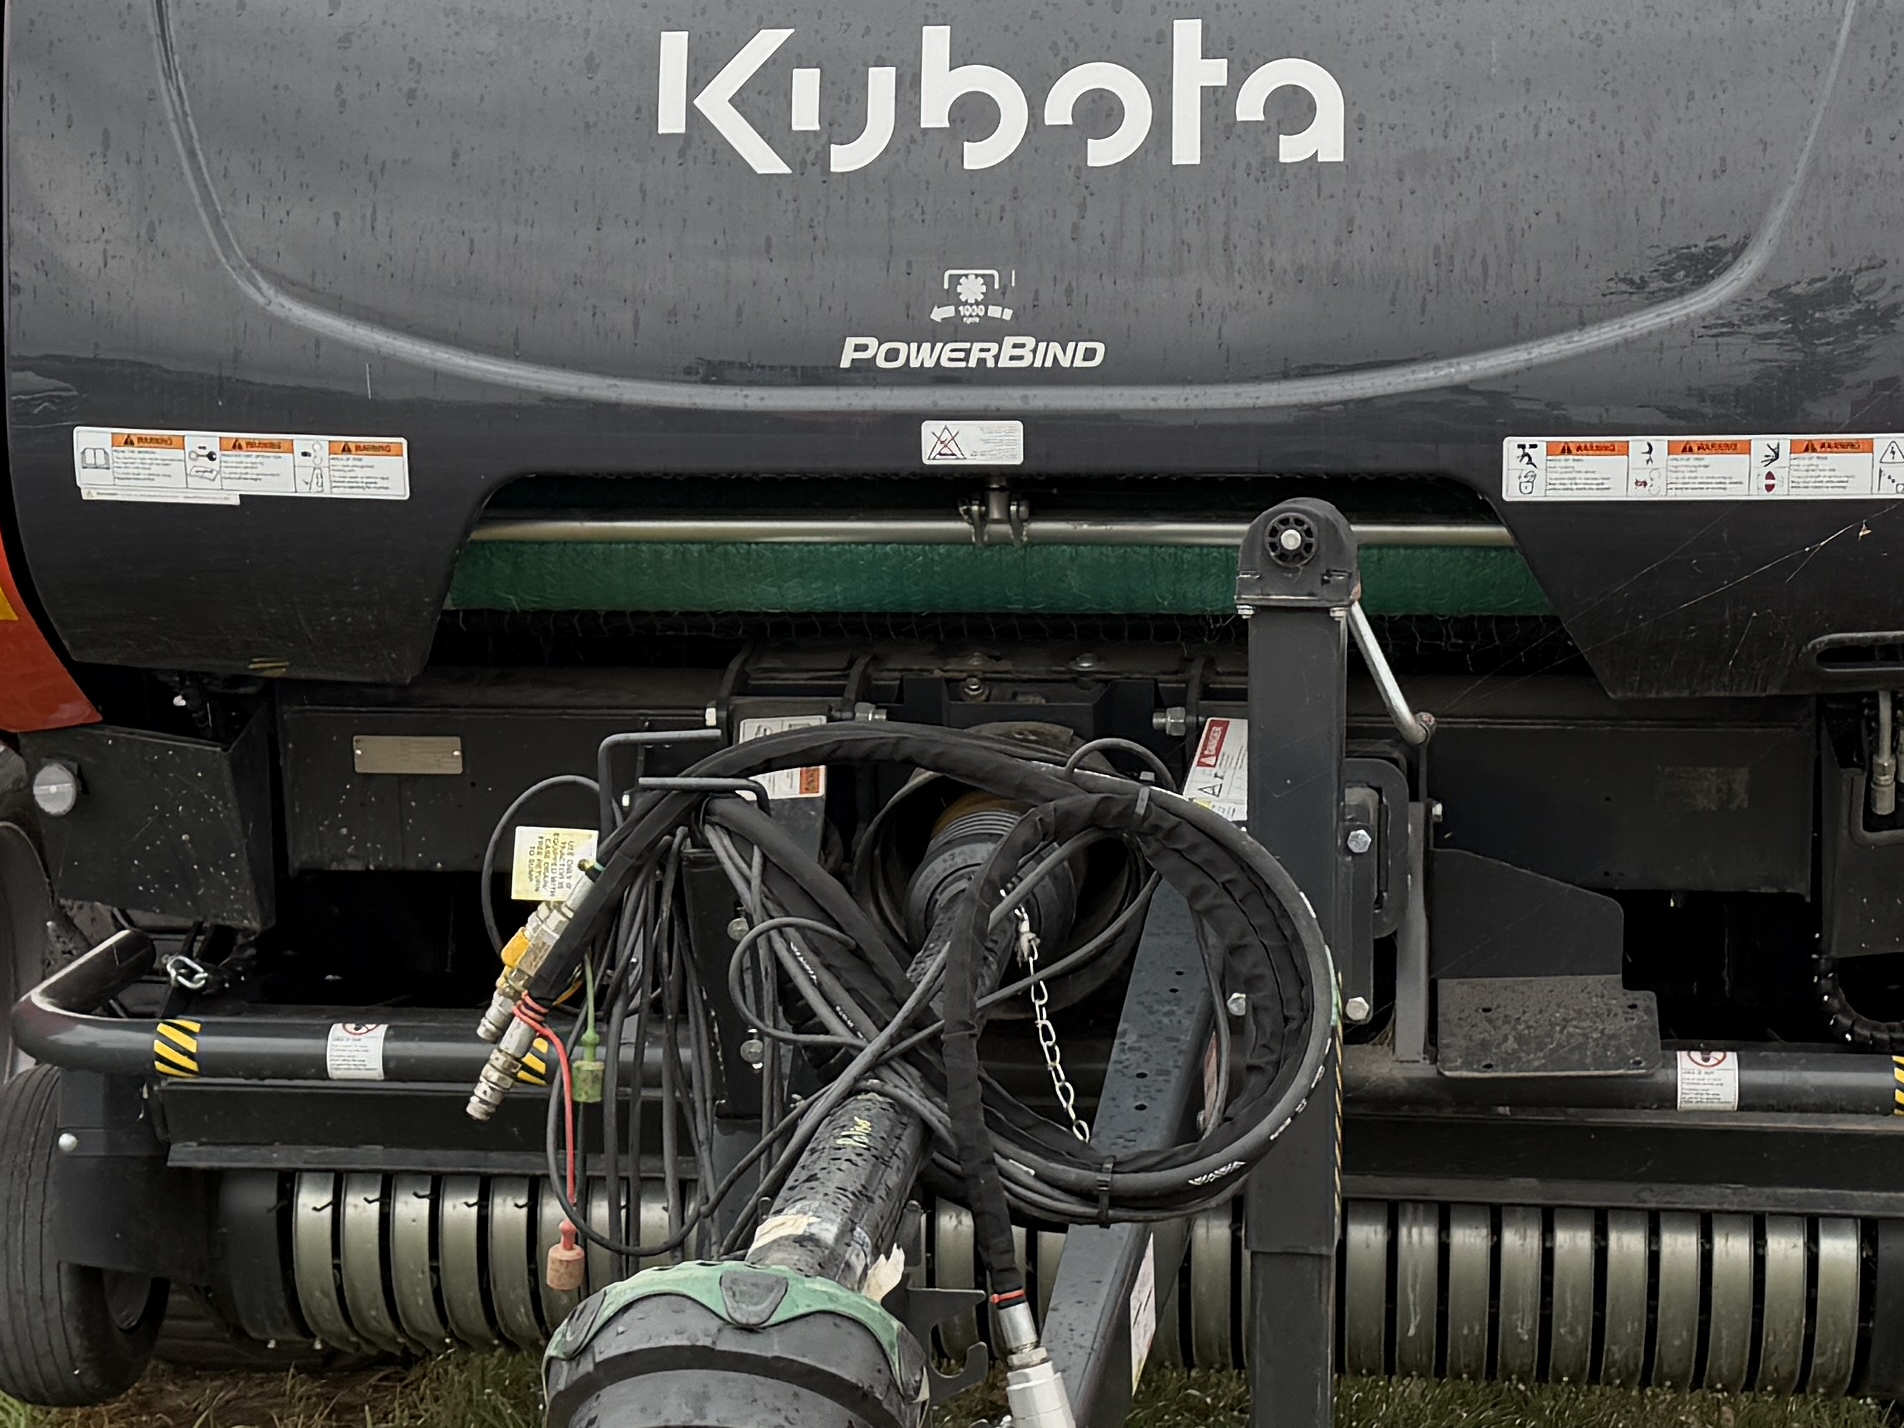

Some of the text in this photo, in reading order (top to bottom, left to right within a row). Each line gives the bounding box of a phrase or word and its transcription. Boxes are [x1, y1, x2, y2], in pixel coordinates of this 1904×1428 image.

[657, 18, 1345, 174] Kubota
[958, 305, 985, 317] 1000
[536, 836, 544, 856] FREE
[543, 838, 552, 859] CASE
